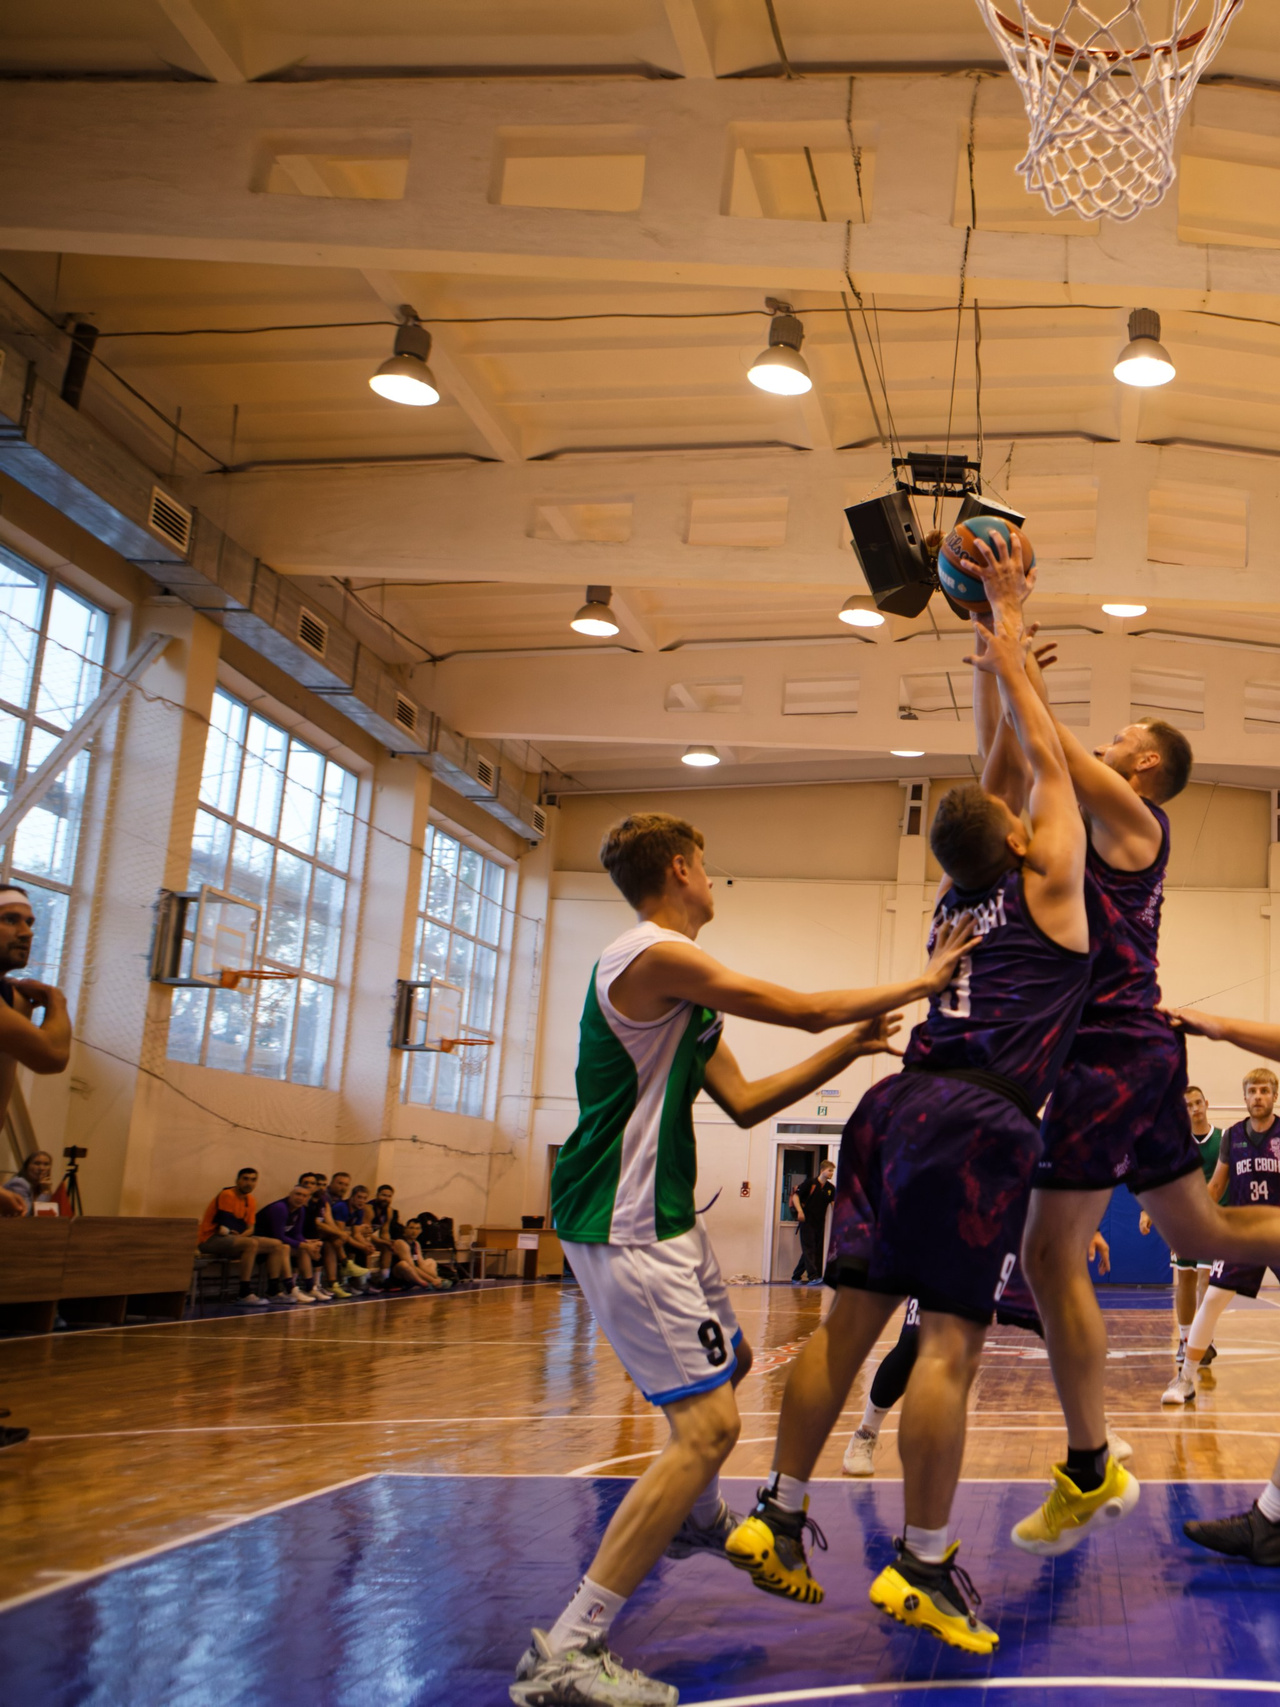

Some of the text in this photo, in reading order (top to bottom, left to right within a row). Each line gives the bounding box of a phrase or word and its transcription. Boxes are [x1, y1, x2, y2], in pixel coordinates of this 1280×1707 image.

[1250, 1180, 1269, 1201] 34
[994, 1252, 1016, 1301] 9
[698, 1319, 727, 1366] 9
